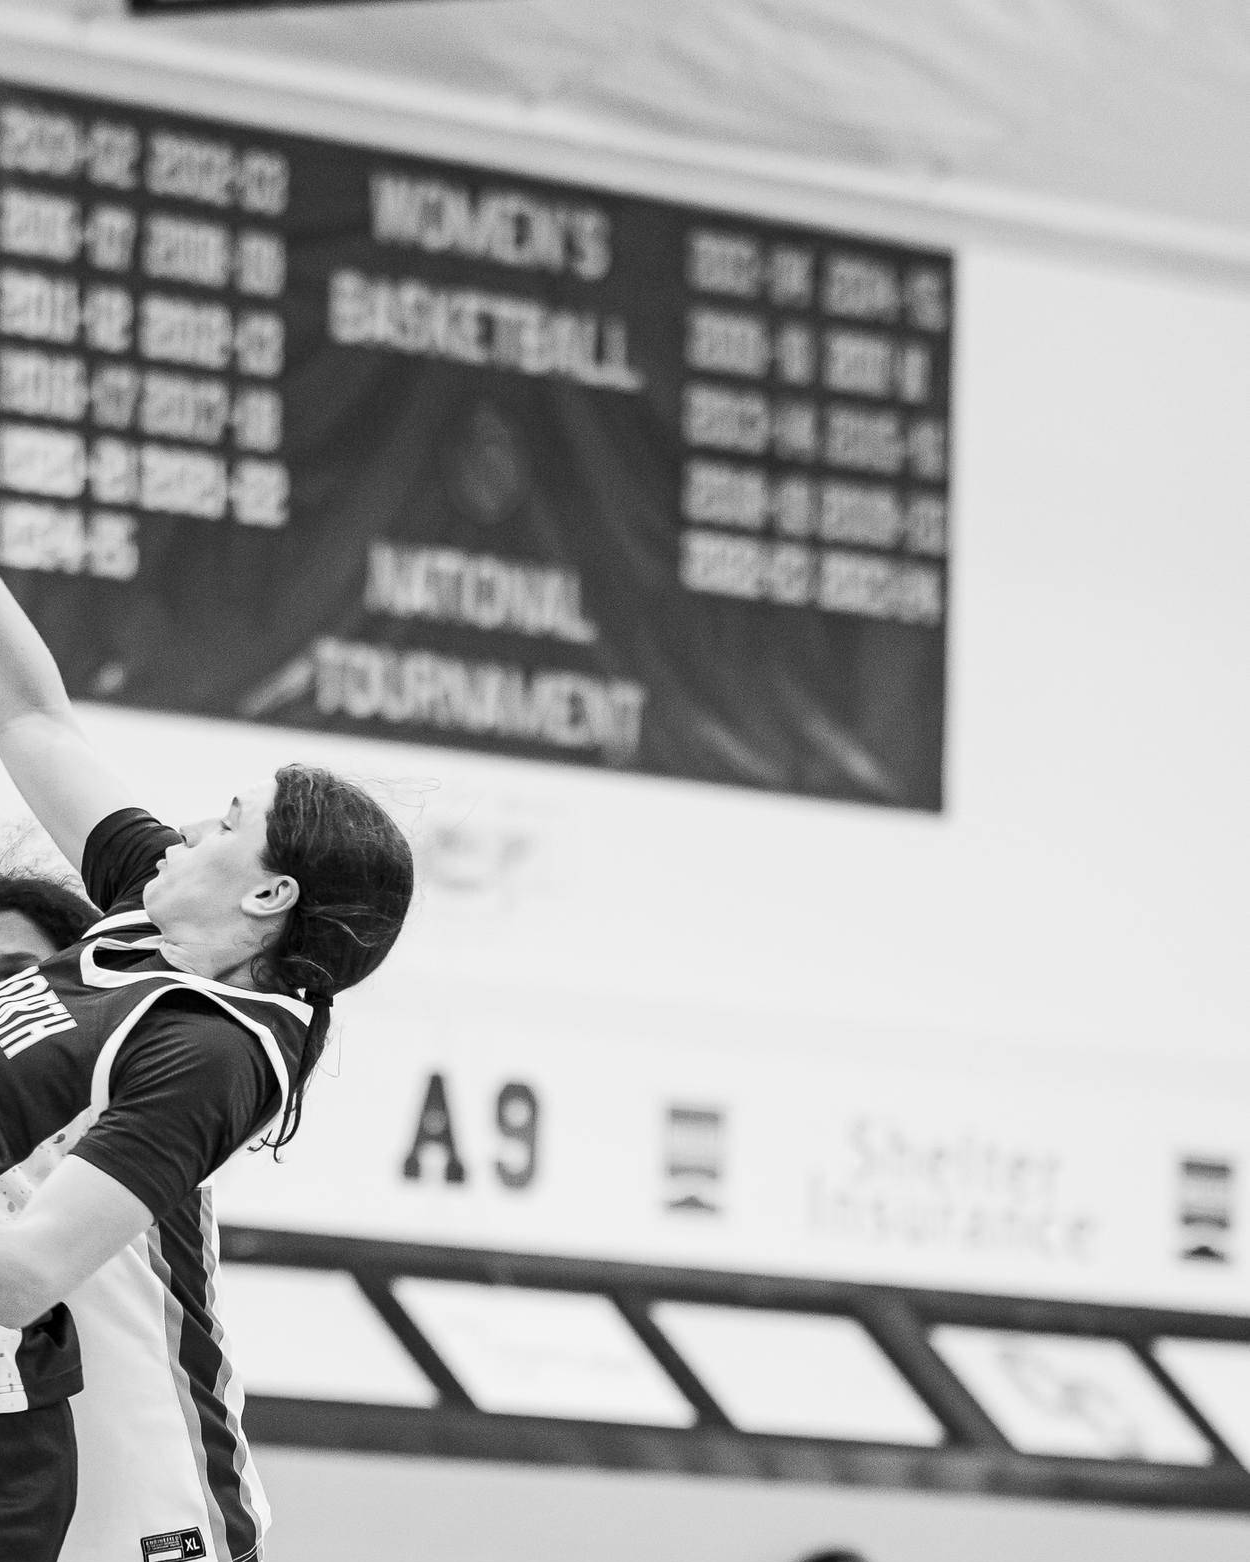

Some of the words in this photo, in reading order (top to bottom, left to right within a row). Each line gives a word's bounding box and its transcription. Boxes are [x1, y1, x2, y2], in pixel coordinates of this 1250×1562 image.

[369, 170, 611, 281] WOMEN'S
[328, 268, 643, 391] BASKETBALL
[364, 540, 596, 645] NATIONAL
[315, 637, 644, 758] TOURNAMENT
[848, 1112, 1063, 1193] Shelter
[805, 1178, 1099, 1261] Insurance
[184, 1537, 200, 1552] XL
